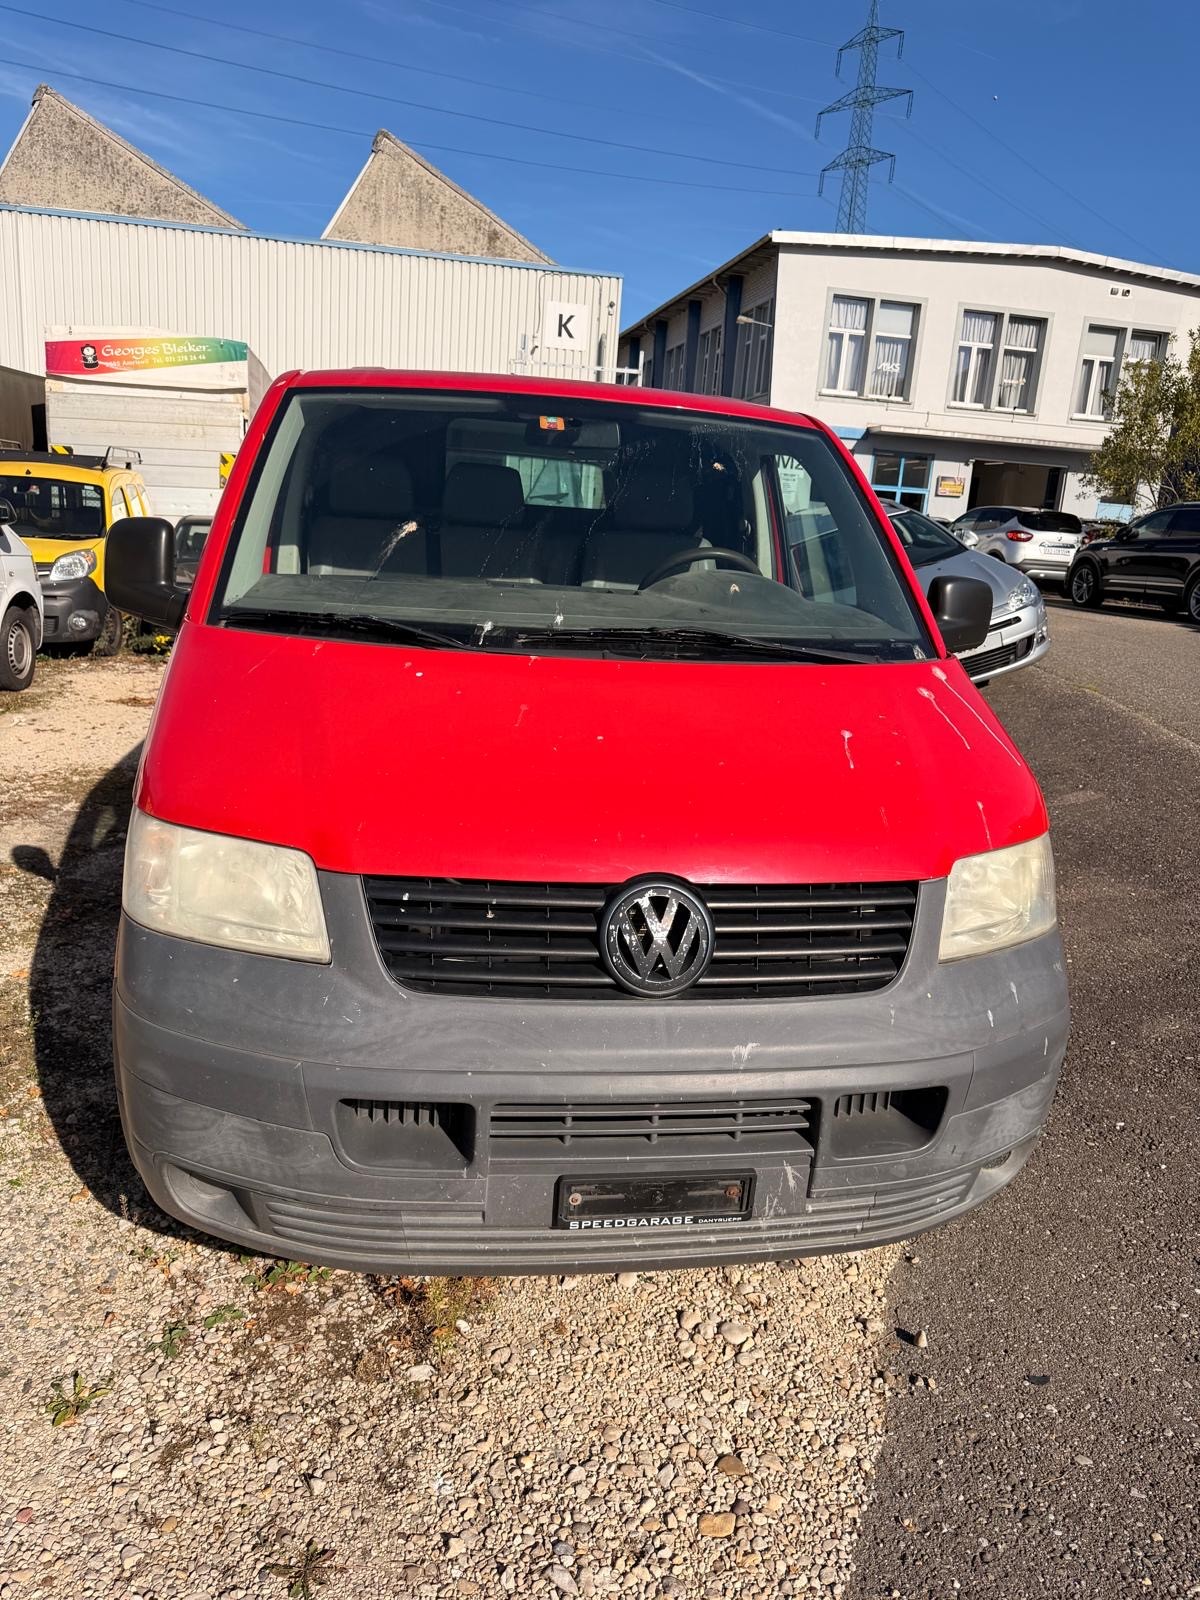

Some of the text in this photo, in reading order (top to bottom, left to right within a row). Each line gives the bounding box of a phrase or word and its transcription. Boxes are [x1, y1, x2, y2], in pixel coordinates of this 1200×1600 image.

[557, 313, 576, 339] K
[101, 345, 160, 360] Georges
[616, 889, 702, 984] VW
[569, 1216, 694, 1230] SPEEDGARAGE
